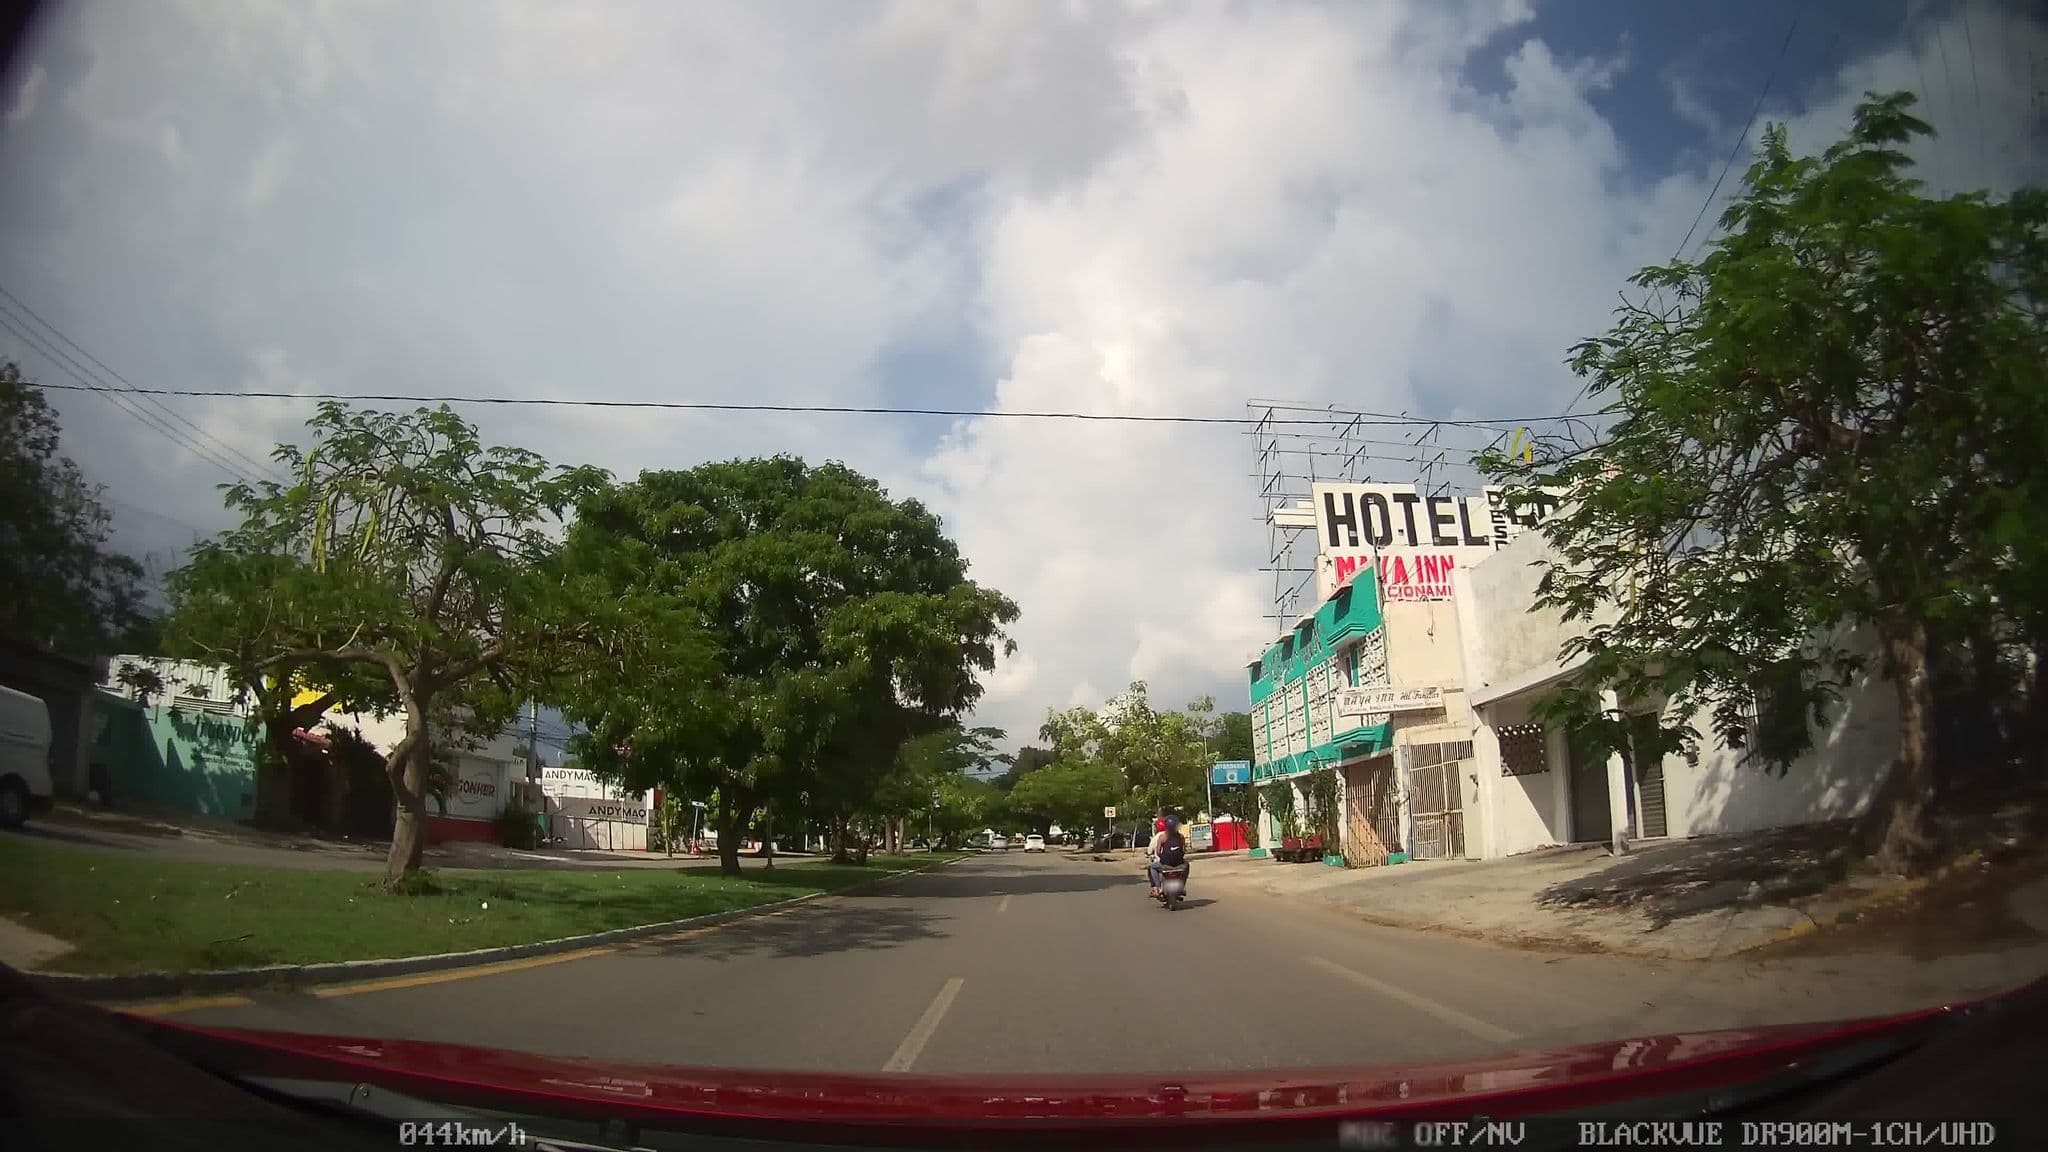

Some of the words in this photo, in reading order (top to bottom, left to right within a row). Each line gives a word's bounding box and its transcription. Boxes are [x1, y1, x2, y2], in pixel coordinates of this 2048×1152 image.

[1324, 492, 1490, 547] HOTEL
[1415, 554, 1455, 584] INN
[588, 805, 647, 818] ANDYMAQ
